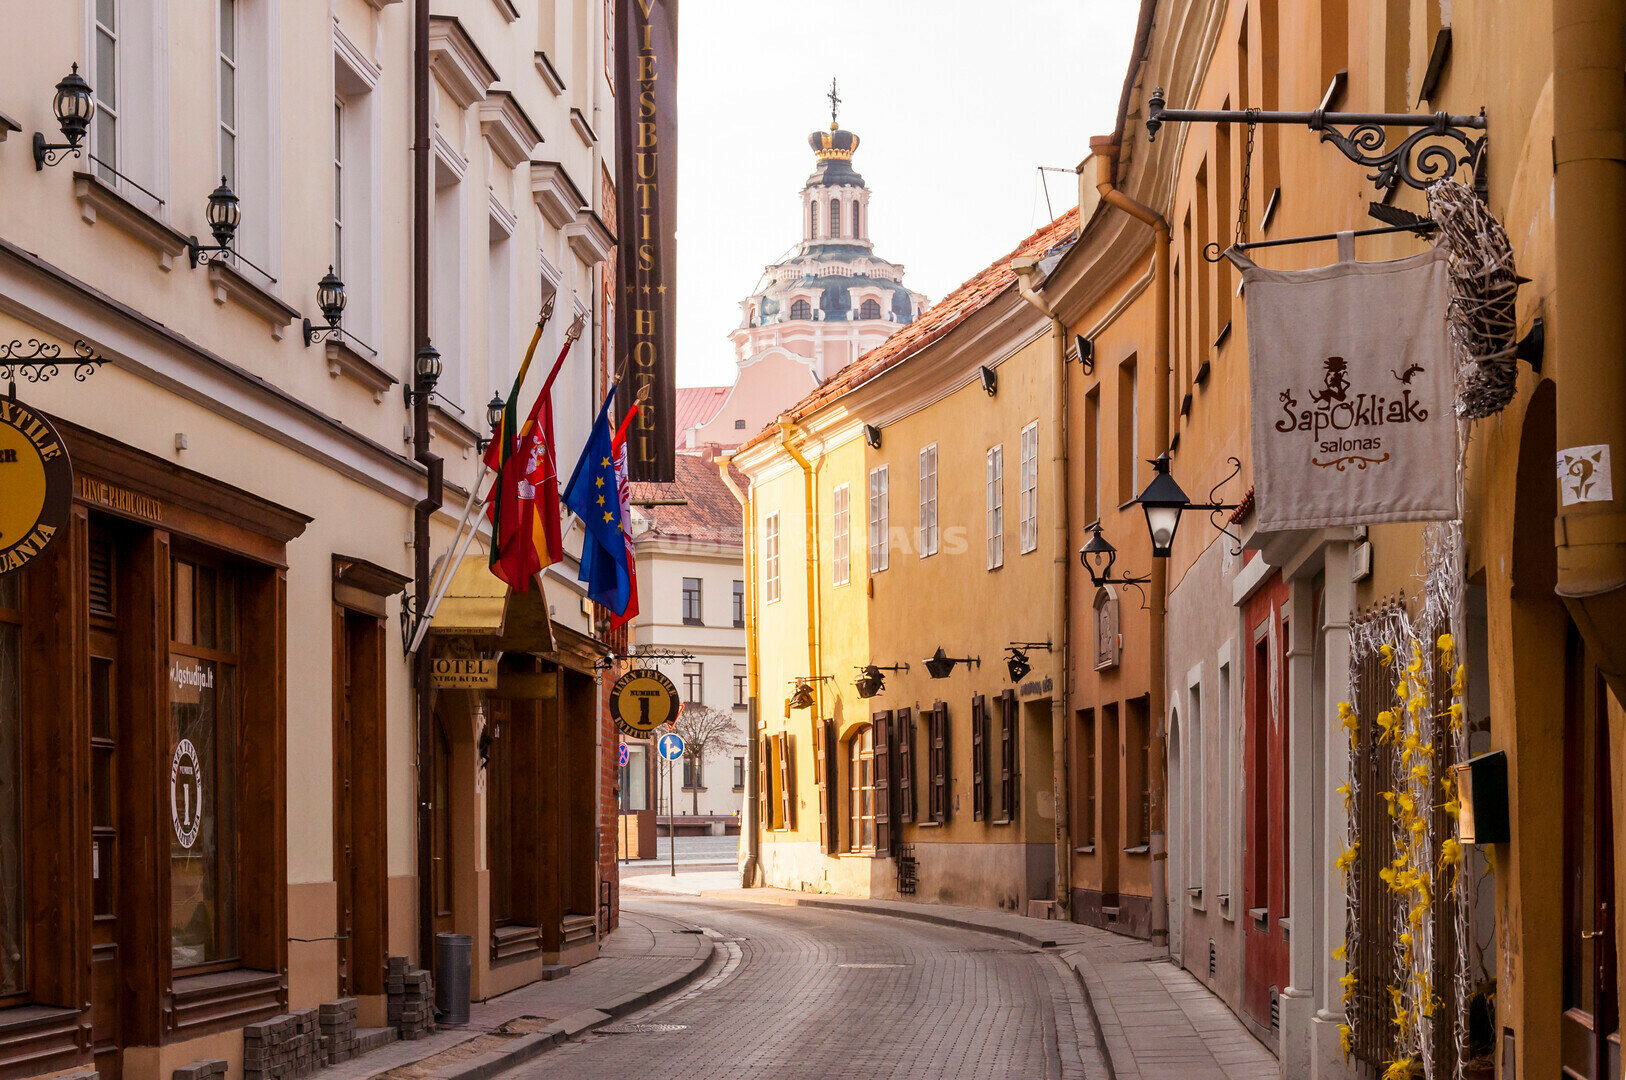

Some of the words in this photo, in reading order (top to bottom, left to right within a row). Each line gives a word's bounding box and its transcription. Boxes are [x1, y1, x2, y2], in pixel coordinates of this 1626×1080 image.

[636, 0, 658, 271] VIEŠBUTIS
[633, 310, 658, 462] HOTEL
[1320, 437, 1381, 453] salonas
[612, 671, 637, 696] LINEN
[640, 670, 677, 697] TEXTILE
